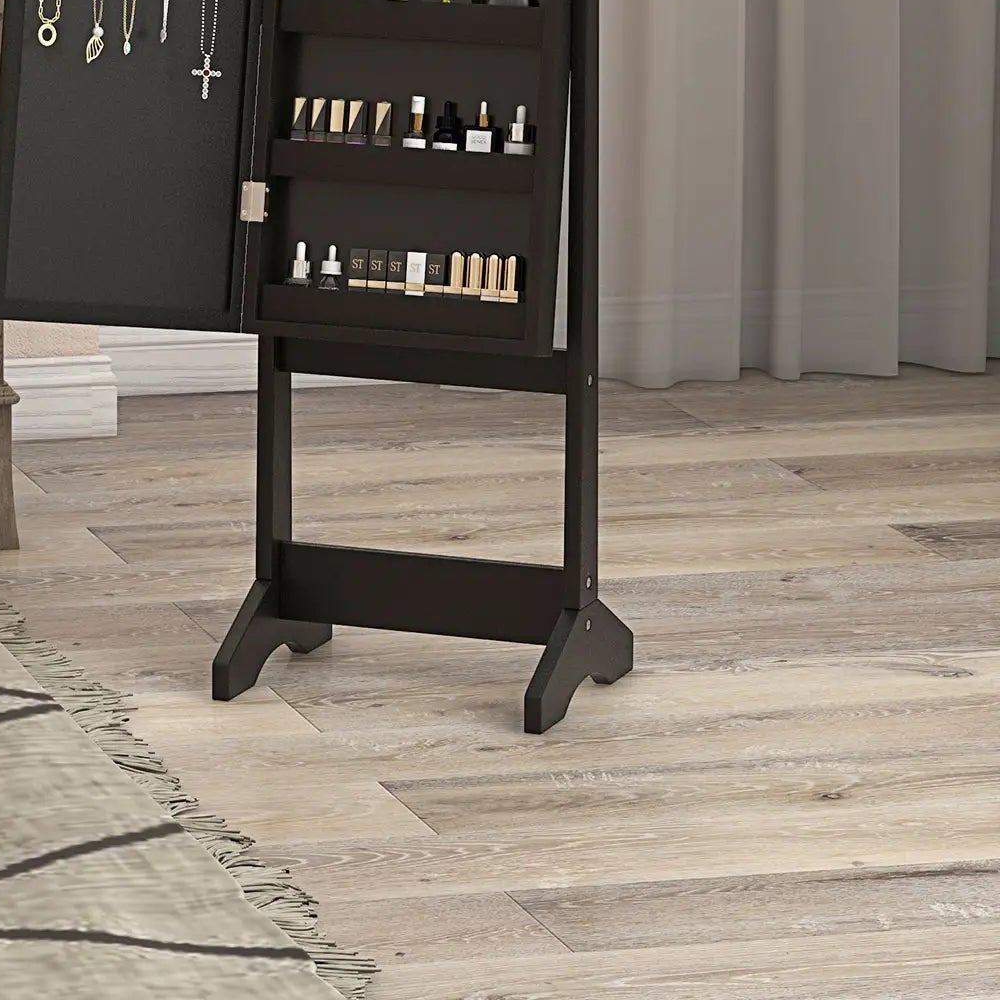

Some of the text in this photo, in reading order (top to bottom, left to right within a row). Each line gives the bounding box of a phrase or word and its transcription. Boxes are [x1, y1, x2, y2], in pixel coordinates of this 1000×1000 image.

[351, 258, 364, 270] ST
[371, 259, 384, 271] ST
[390, 261, 402, 272] ST
[409, 262, 422, 273] ST
[428, 263, 441, 275] ST
